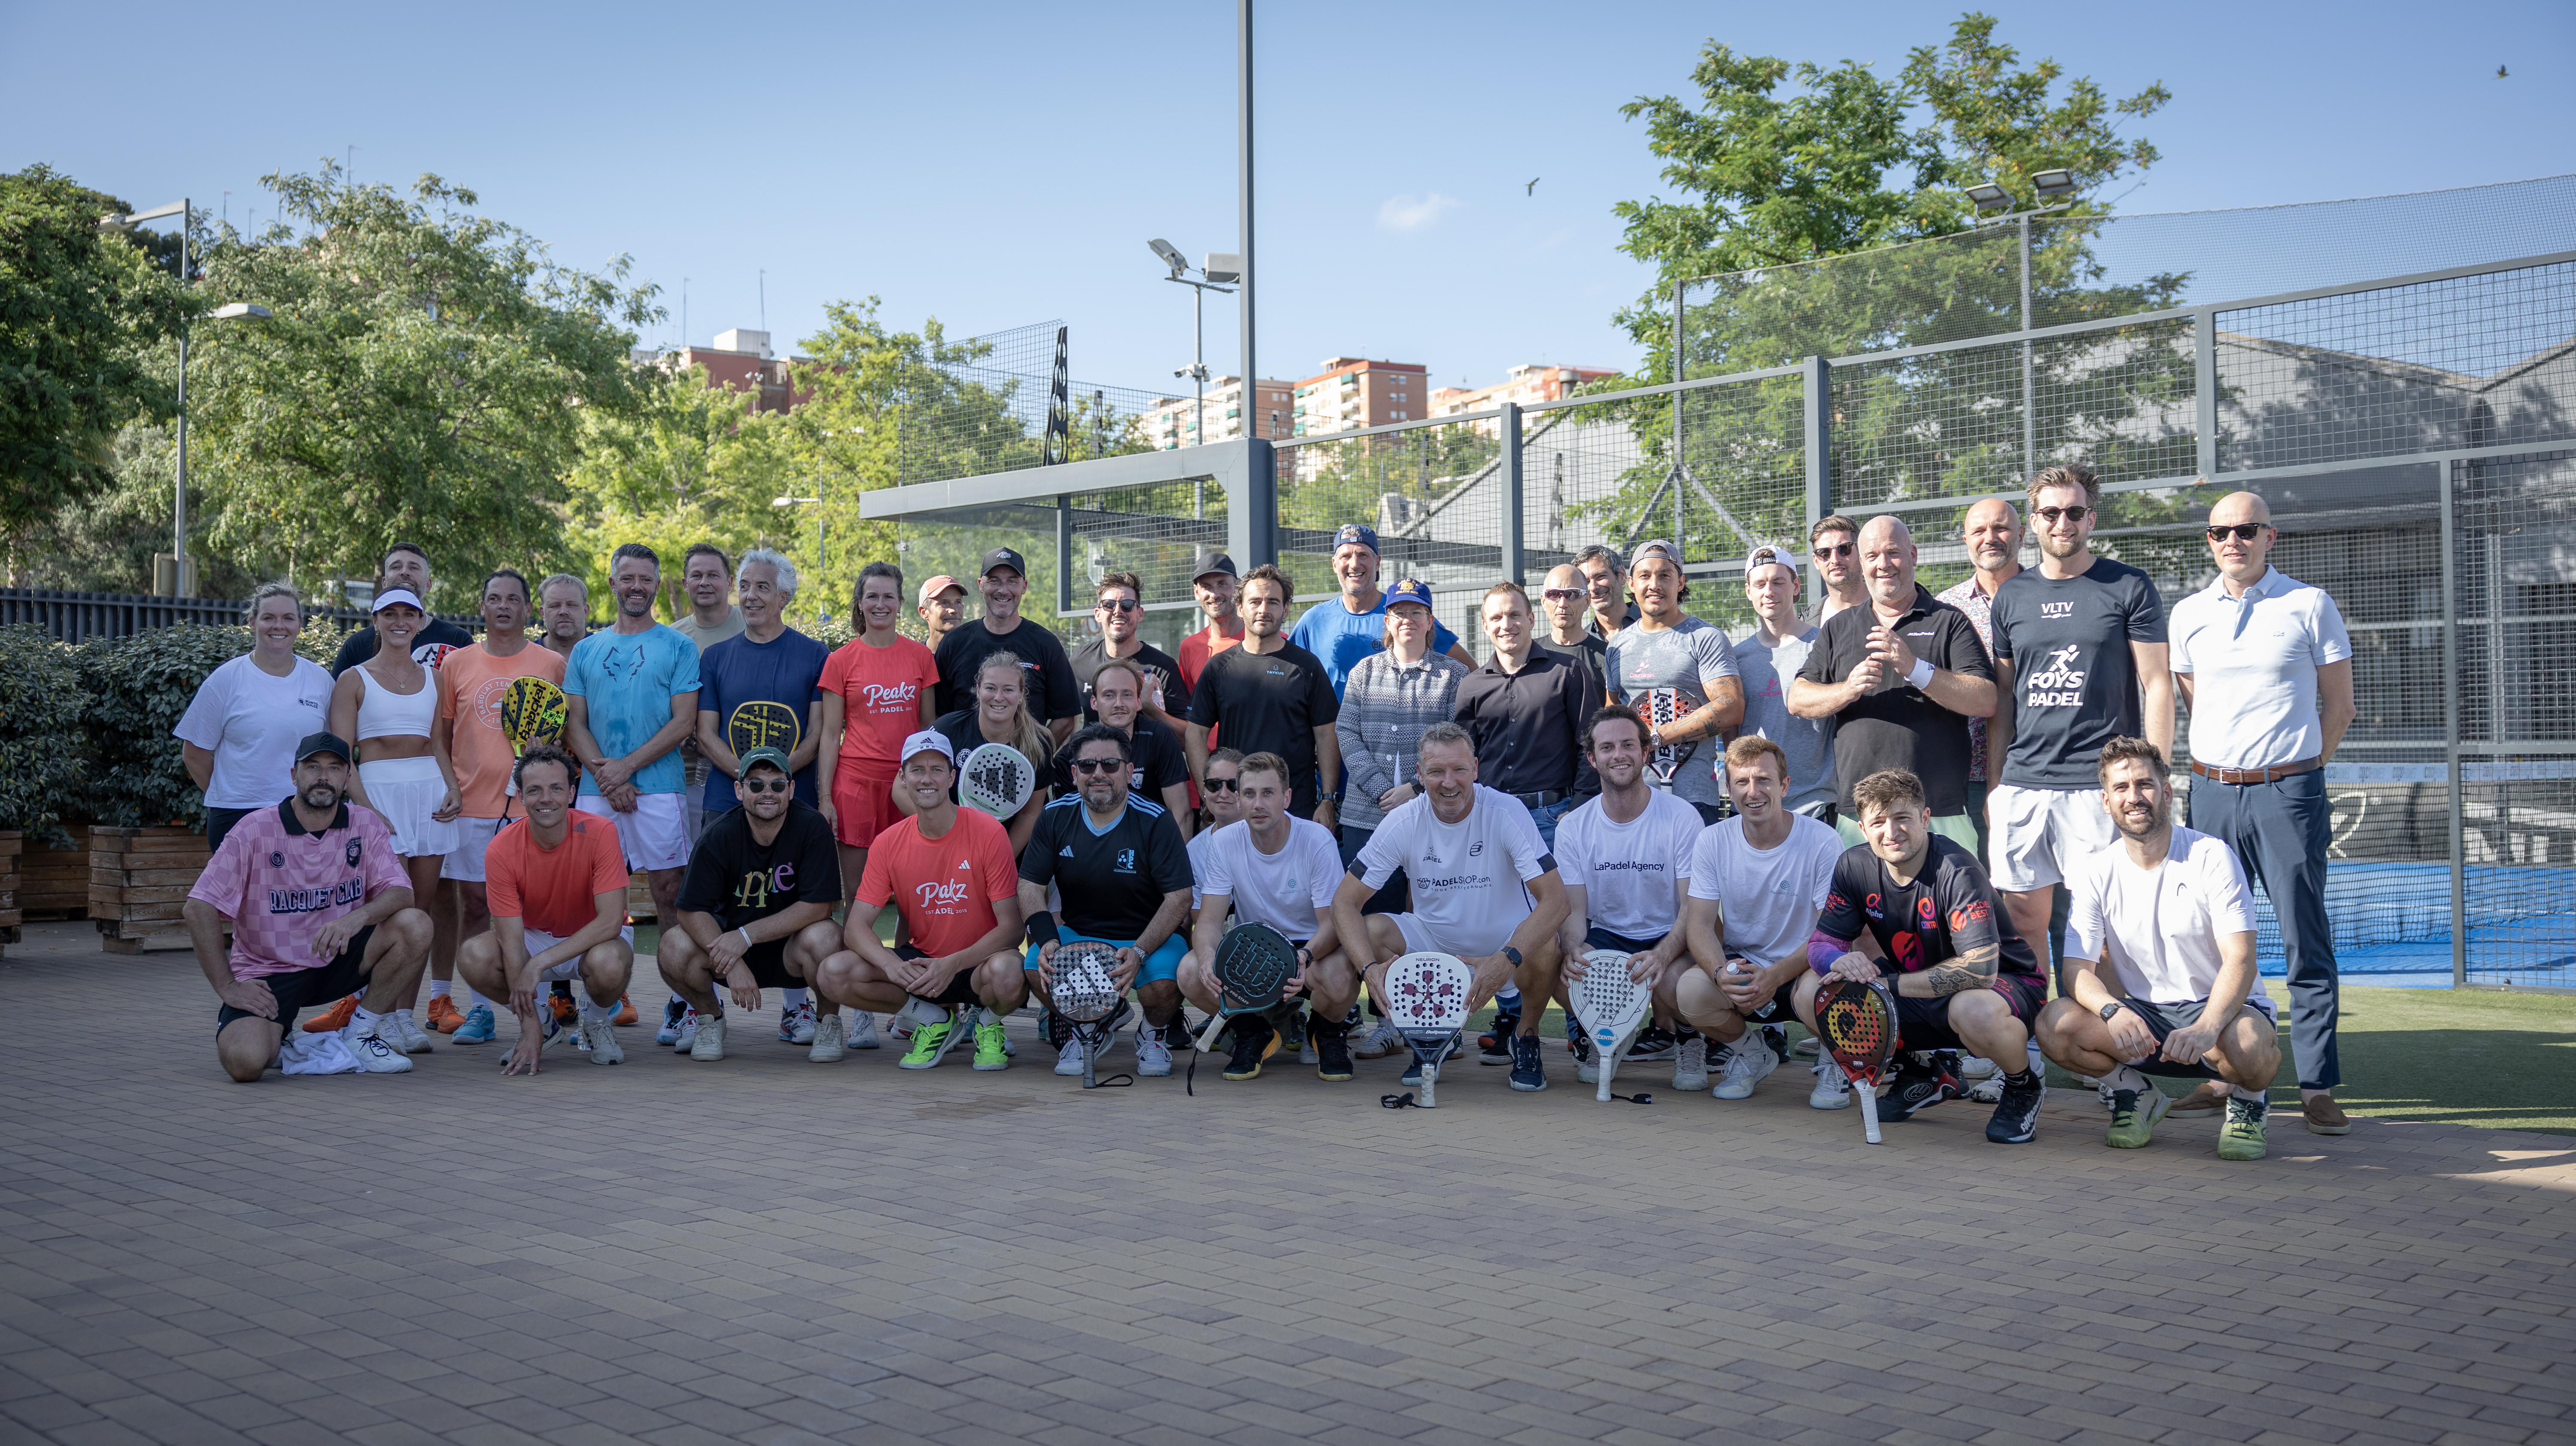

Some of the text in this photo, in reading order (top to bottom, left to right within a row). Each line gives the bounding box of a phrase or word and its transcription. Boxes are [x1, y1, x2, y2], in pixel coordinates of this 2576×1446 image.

[2041, 601, 2074, 614] VLTV
[2028, 671, 2085, 689] FOYS
[478, 683, 493, 714] BABOLAT
[863, 682, 916, 707] Peakz
[2028, 692, 2084, 707] PADEL
[520, 680, 546, 741] Babolat
[1657, 689, 1670, 758] Bolat
[1595, 861, 1665, 872] LaPadel Agency
[268, 887, 334, 914] RACQUET
[916, 878, 968, 908] Pakz
[1828, 894, 1846, 905] ADEL
[935, 907, 954, 915] ADEL
[1866, 908, 1883, 919] Alpha
[1970, 909, 1989, 920] BEST
[1238, 996, 1249, 1005] STAFF
